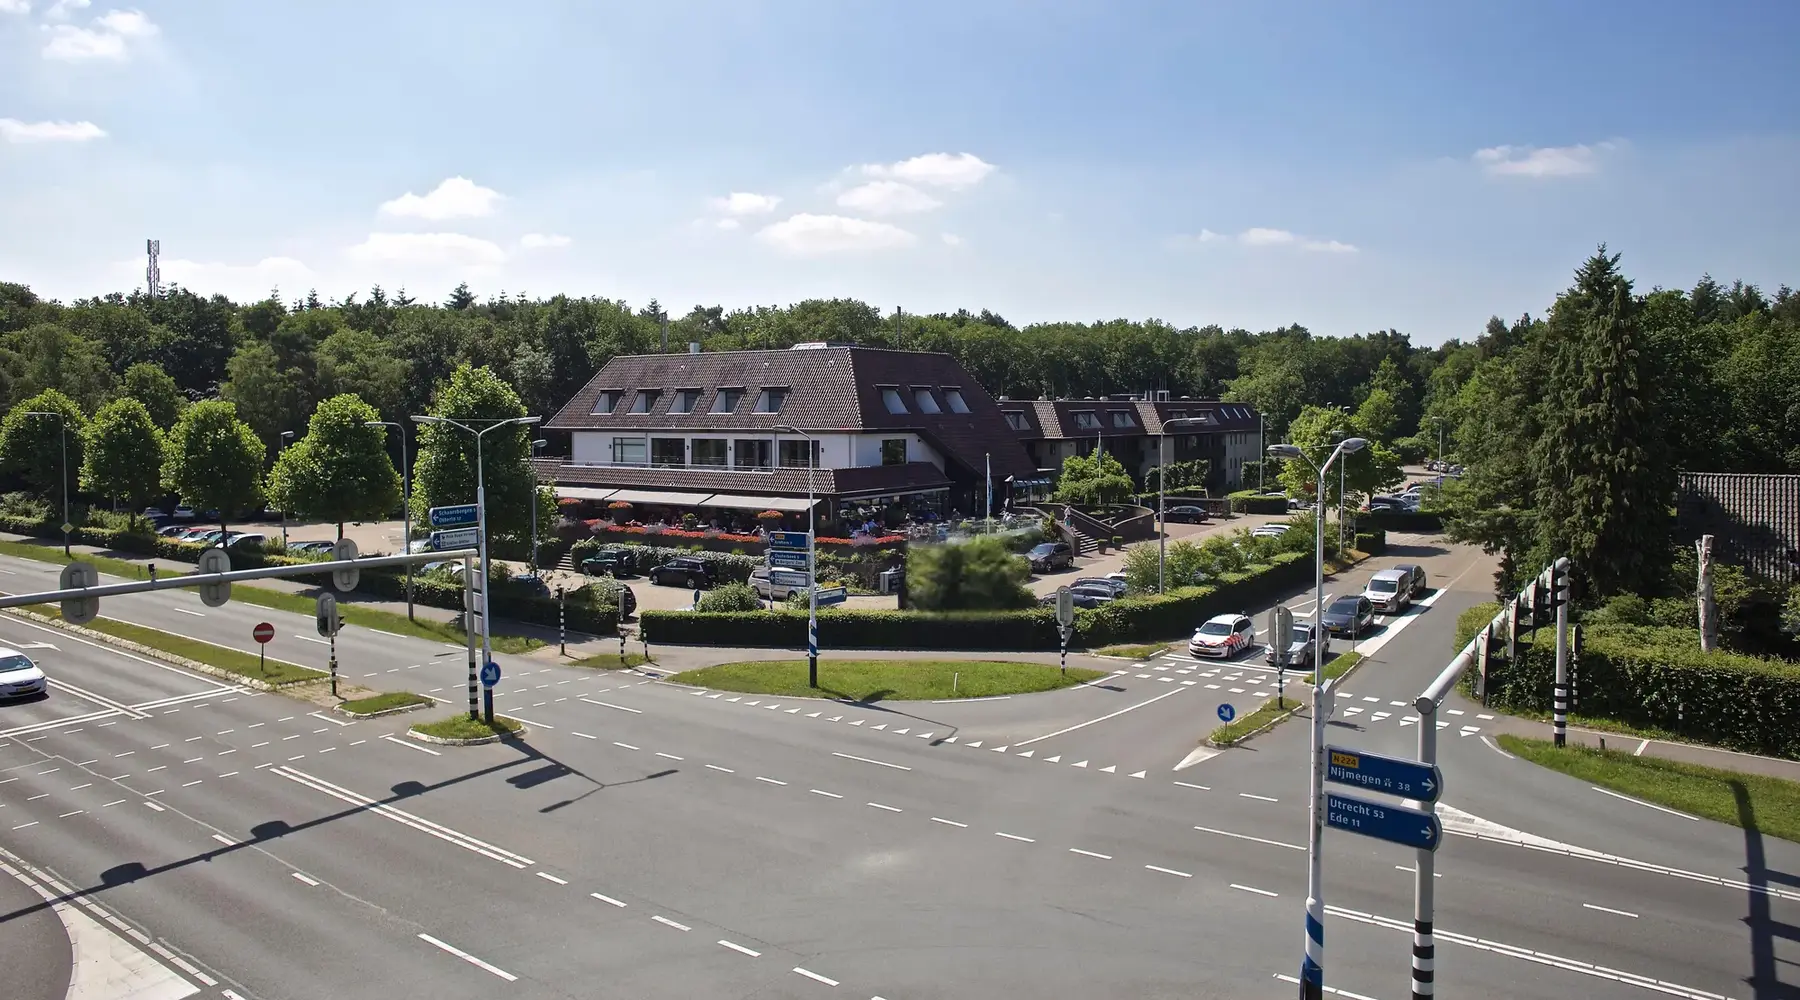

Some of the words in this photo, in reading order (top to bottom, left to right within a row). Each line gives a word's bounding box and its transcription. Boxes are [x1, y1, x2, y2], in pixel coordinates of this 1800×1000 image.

[1333, 754, 1357, 767] N224
[1330, 766, 1381, 785] Nijmegen
[1397, 782, 1411, 791] 38
[1330, 798, 1370, 816] Utrecht
[1373, 810, 1385, 819] 53
[1330, 812, 1348, 825] Ede
[1352, 819, 1360, 827] 11
